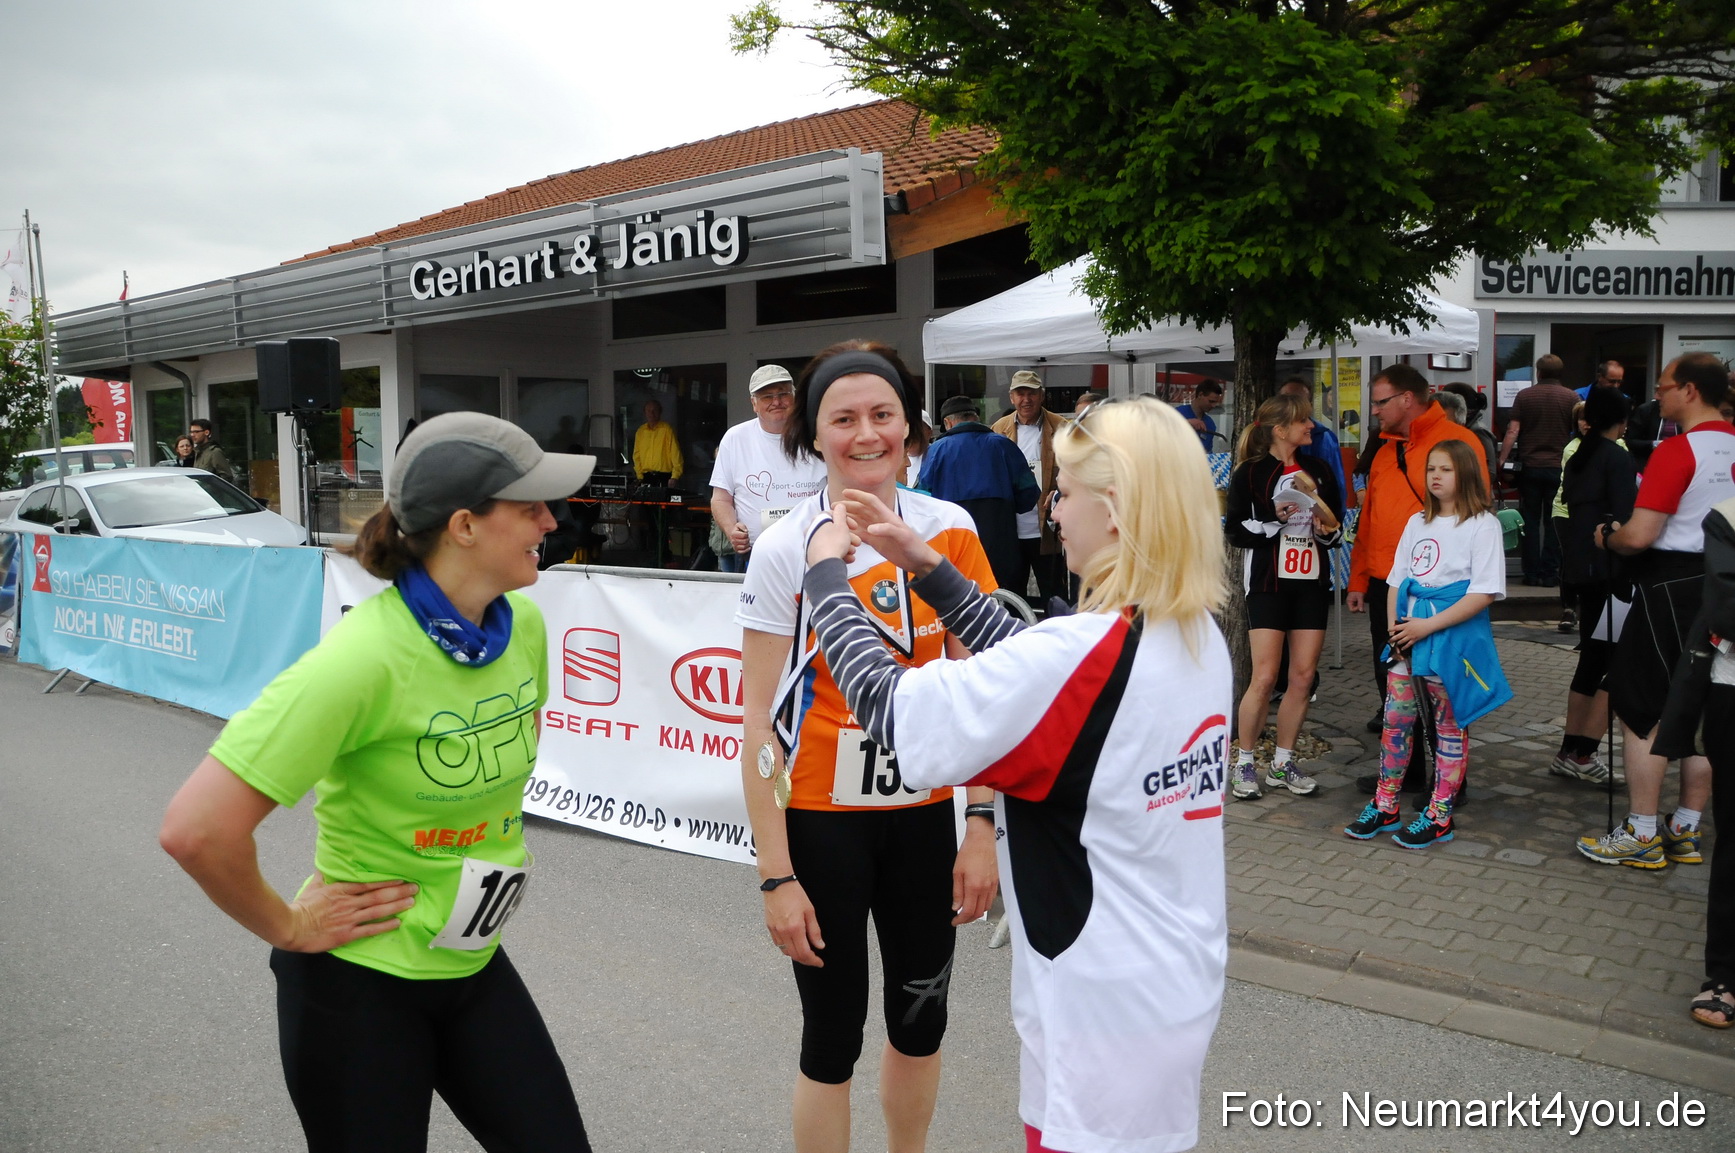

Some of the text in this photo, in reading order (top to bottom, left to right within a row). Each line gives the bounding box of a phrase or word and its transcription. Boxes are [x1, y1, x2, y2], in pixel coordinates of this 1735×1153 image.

[409, 210, 743, 300] Gerhart & Jänig
[749, 481, 765, 489] Herz
[771, 482, 790, 491] Sport
[787, 489, 819, 499] Neumarkt
[1284, 547, 1313, 575] 80
[52, 570, 226, 617] SO HABEN SIE NISSAN
[54, 606, 198, 656] NOCH NIE ERLEBT.
[546, 710, 640, 741] SEAT
[659, 725, 696, 753] KIA
[859, 738, 919, 797] 13
[416, 791, 467, 803] Gebäude-
[414, 821, 489, 852] MERZ
